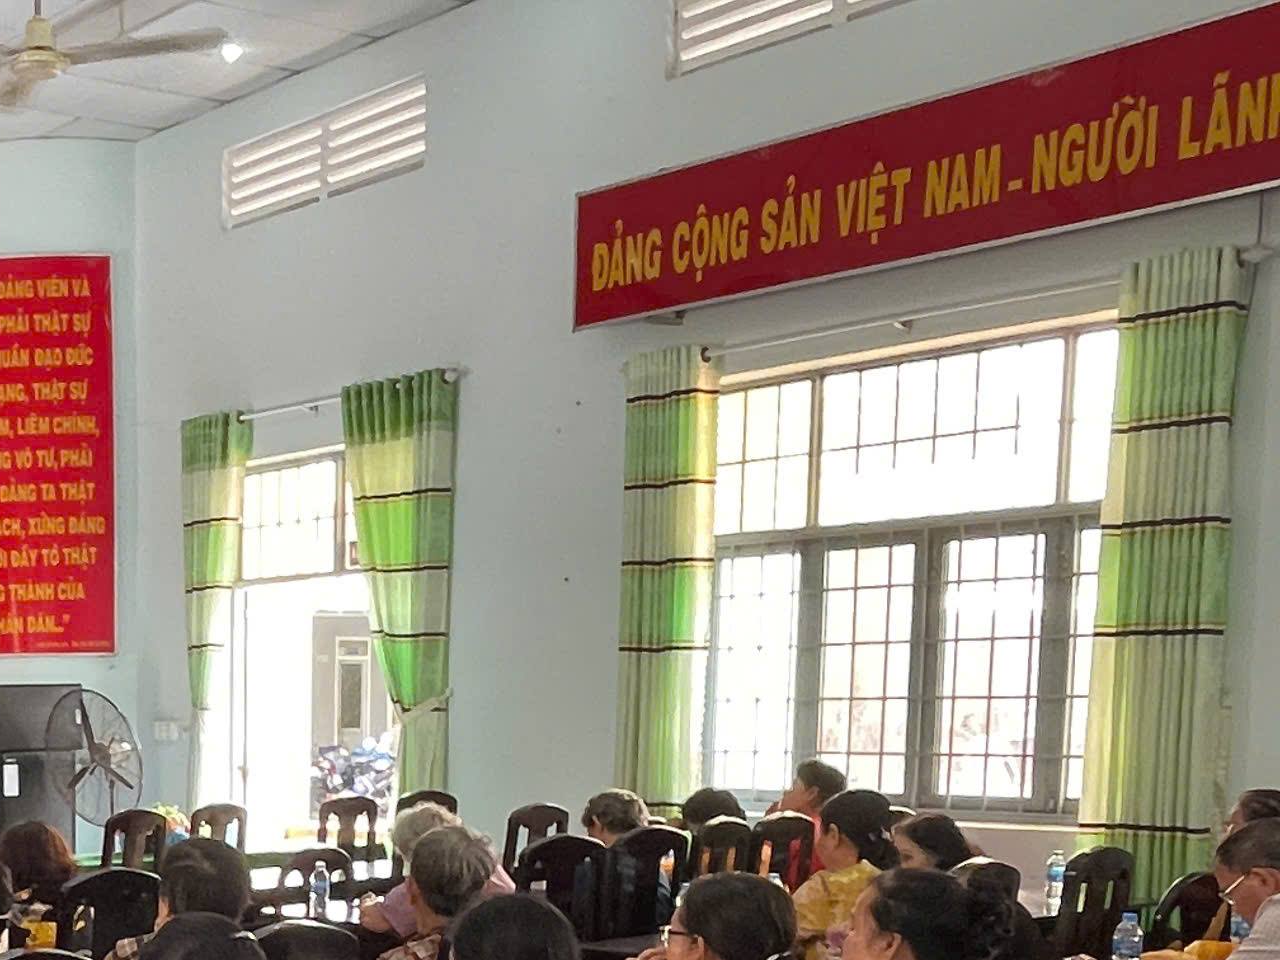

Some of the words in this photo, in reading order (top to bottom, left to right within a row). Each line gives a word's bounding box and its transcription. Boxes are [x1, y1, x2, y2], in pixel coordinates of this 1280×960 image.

[591, 219, 663, 292] ĐẢNG
[672, 203, 749, 283] CỘNG
[760, 174, 822, 254] SẢN
[836, 160, 912, 245] VIỆT
[923, 143, 1001, 218] NAM
[1031, 95, 1159, 194] NGƯỜI
[72, 272, 92, 298] VÀ
[33, 308, 70, 336] THẬT
[32, 377, 67, 405] THẬT
[39, 482, 57, 502] TA
[59, 478, 96, 506] THẬT
[62, 541, 97, 571] THẬT
